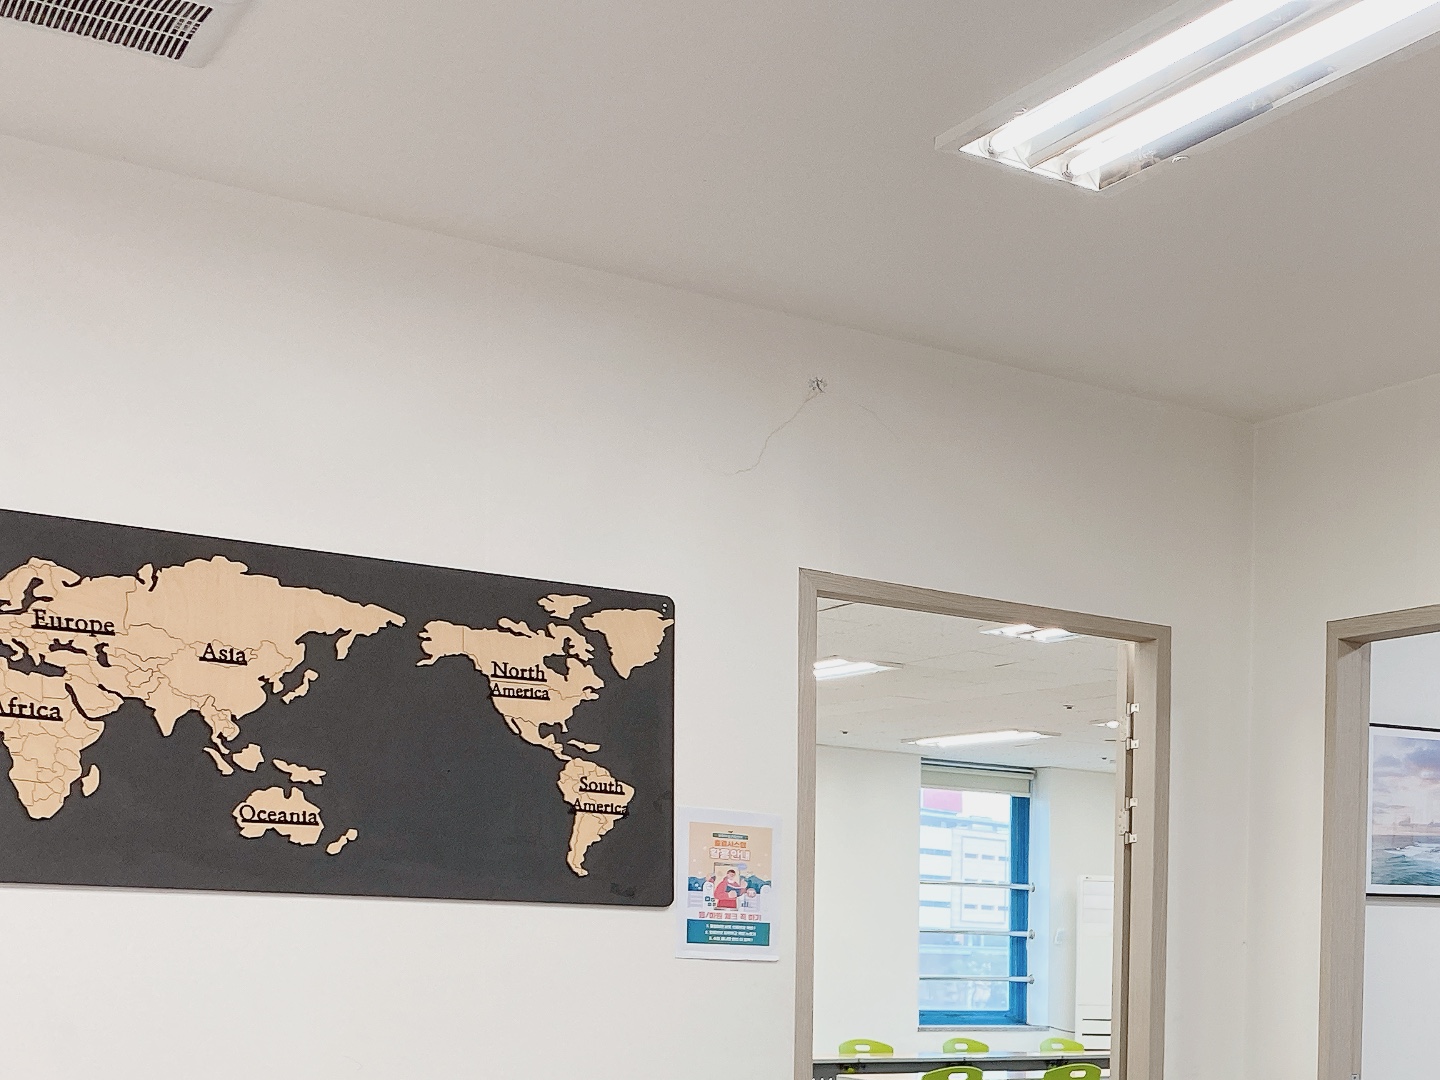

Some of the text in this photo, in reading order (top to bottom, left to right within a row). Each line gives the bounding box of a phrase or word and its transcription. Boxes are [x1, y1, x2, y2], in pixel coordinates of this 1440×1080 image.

[33, 609, 115, 637] Europe
[203, 643, 247, 665] Asia
[491, 661, 546, 681] North
[492, 683, 550, 700] America
[579, 776, 624, 793] South
[239, 804, 318, 824] Oceania
[574, 798, 628, 815] America
